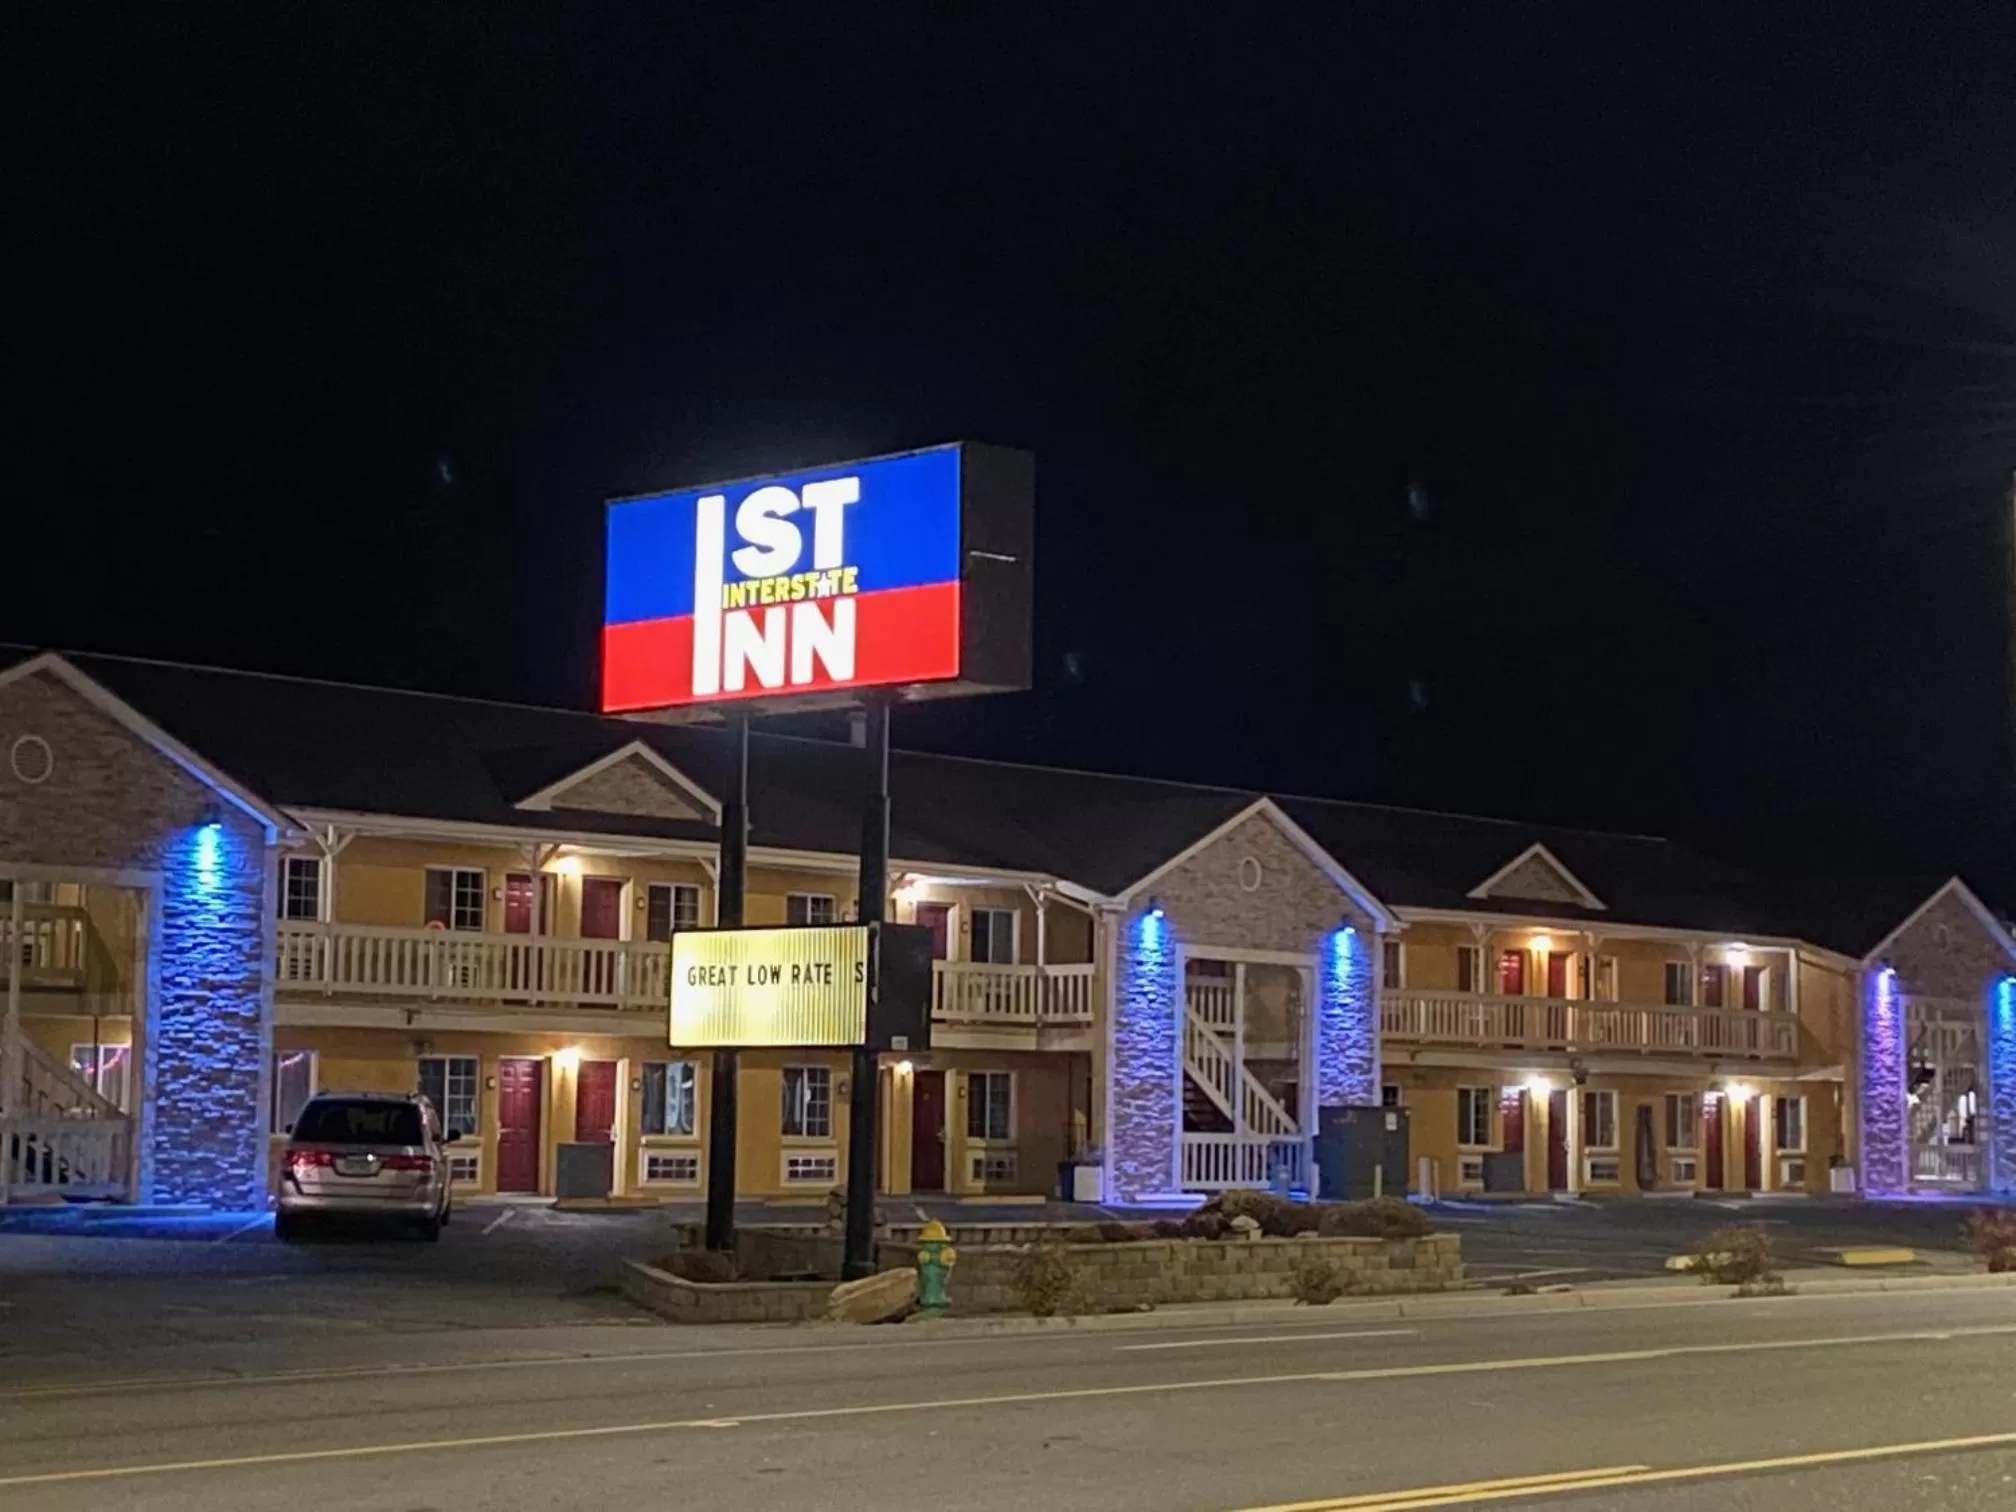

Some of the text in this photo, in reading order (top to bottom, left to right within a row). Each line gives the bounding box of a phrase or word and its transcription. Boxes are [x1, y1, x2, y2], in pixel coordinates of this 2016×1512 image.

[687, 964, 738, 987] GREAT
[747, 963, 781, 986] LOW
[791, 962, 832, 985] RATE
